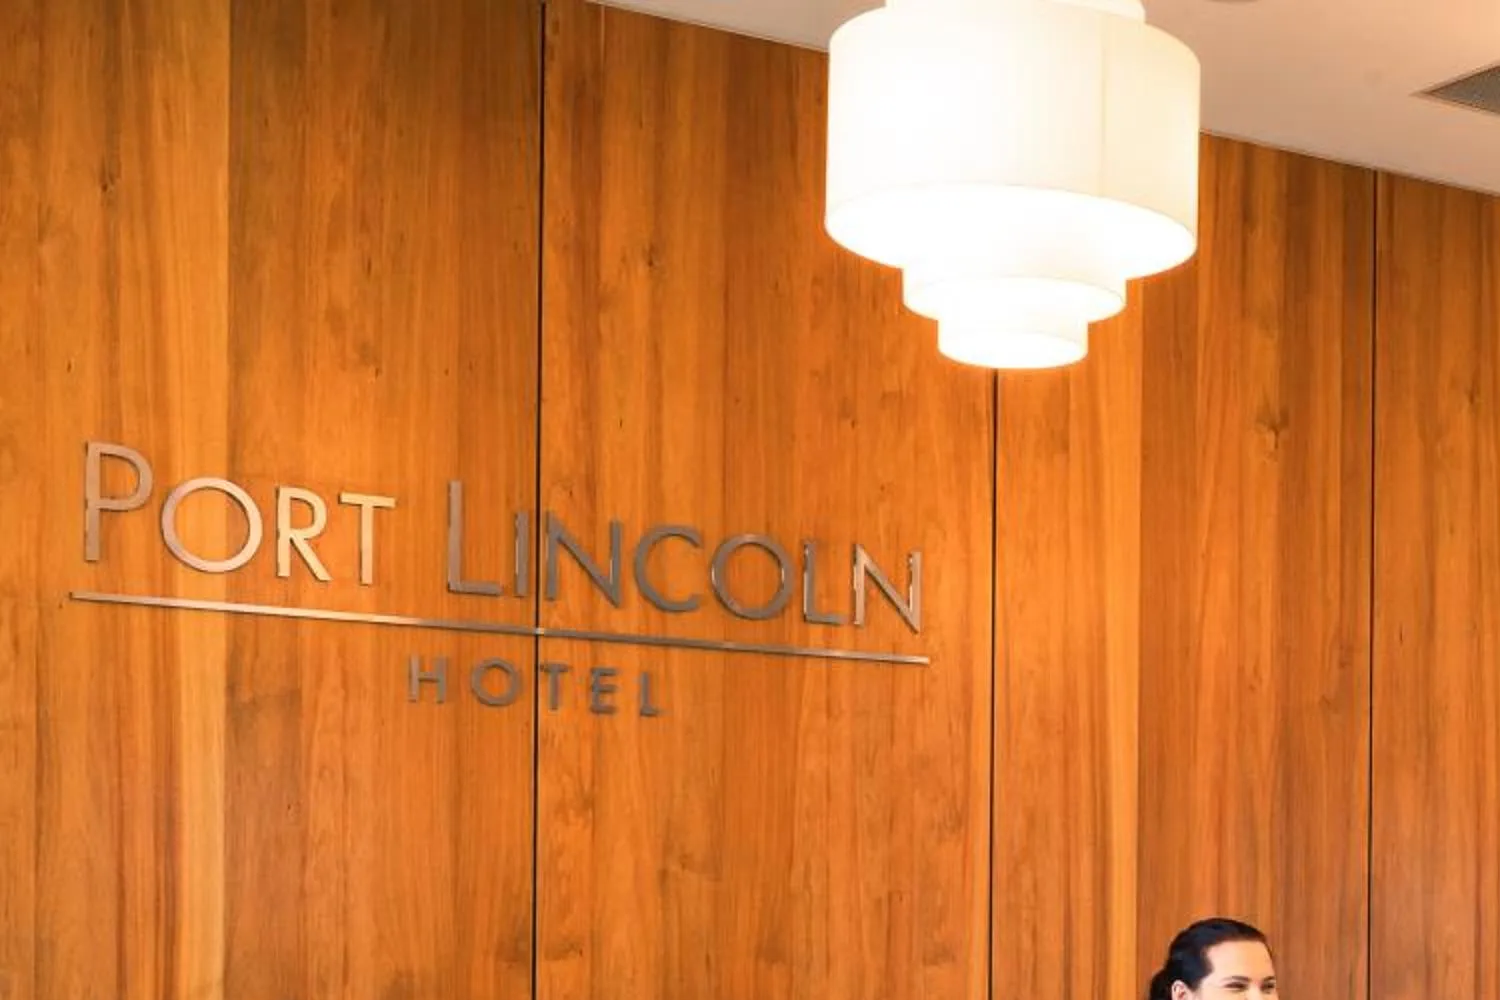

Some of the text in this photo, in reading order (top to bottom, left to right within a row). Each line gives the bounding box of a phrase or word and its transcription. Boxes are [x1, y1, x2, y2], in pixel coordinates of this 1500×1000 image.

[84, 441, 923, 634] PORT LINCOLN
[407, 655, 665, 717] HOTEL
